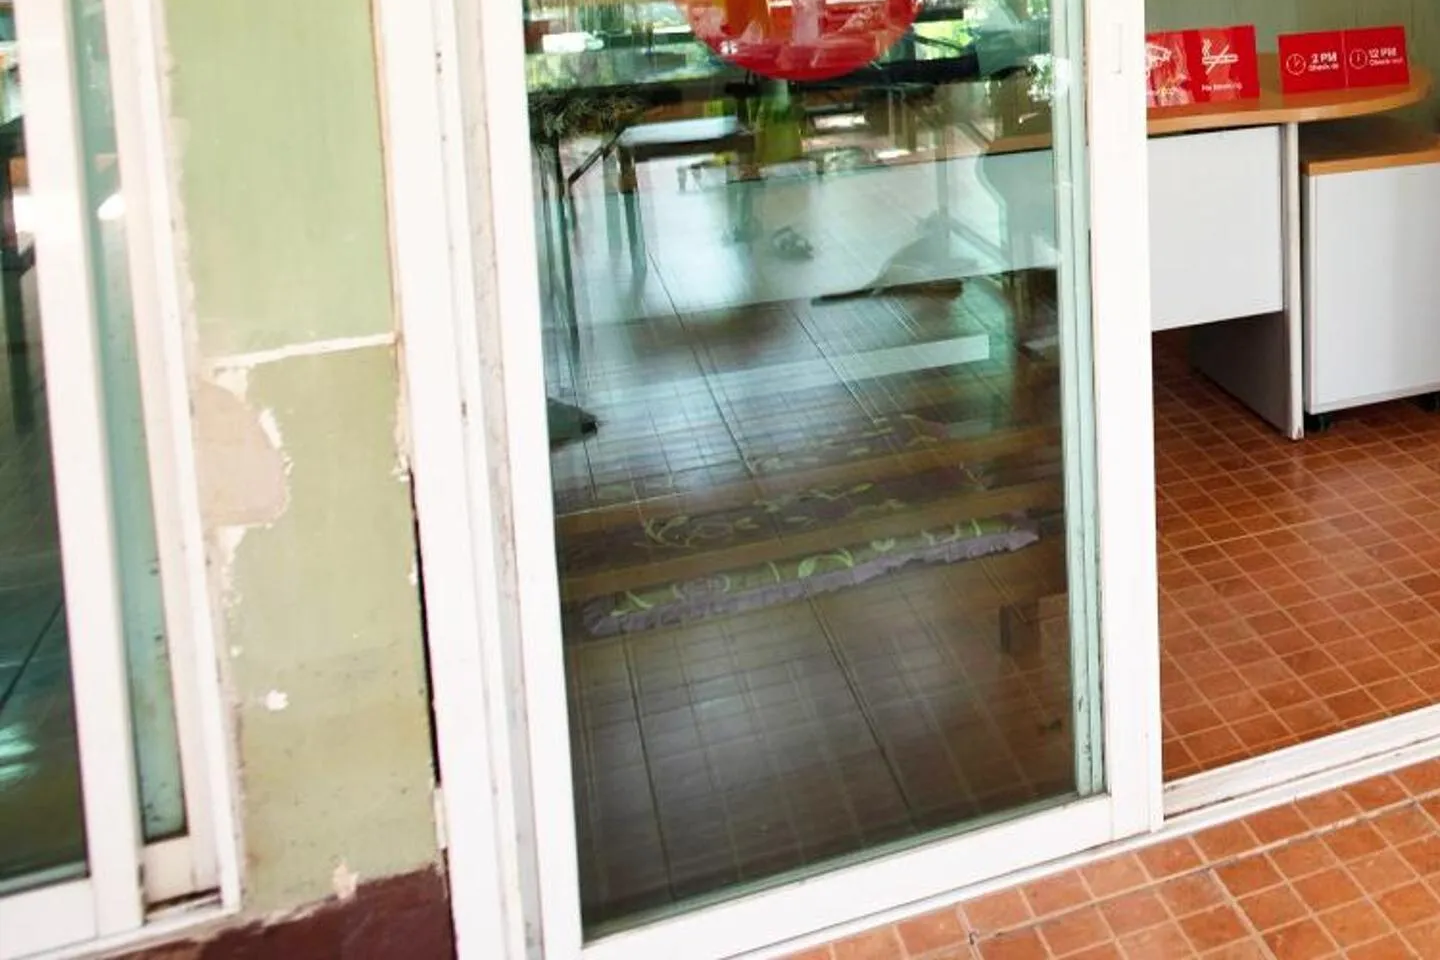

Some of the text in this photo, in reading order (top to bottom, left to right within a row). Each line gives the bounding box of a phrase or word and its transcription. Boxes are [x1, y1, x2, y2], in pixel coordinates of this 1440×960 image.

[1320, 51, 1337, 62] PM
[1369, 47, 1396, 58] 12 PM
